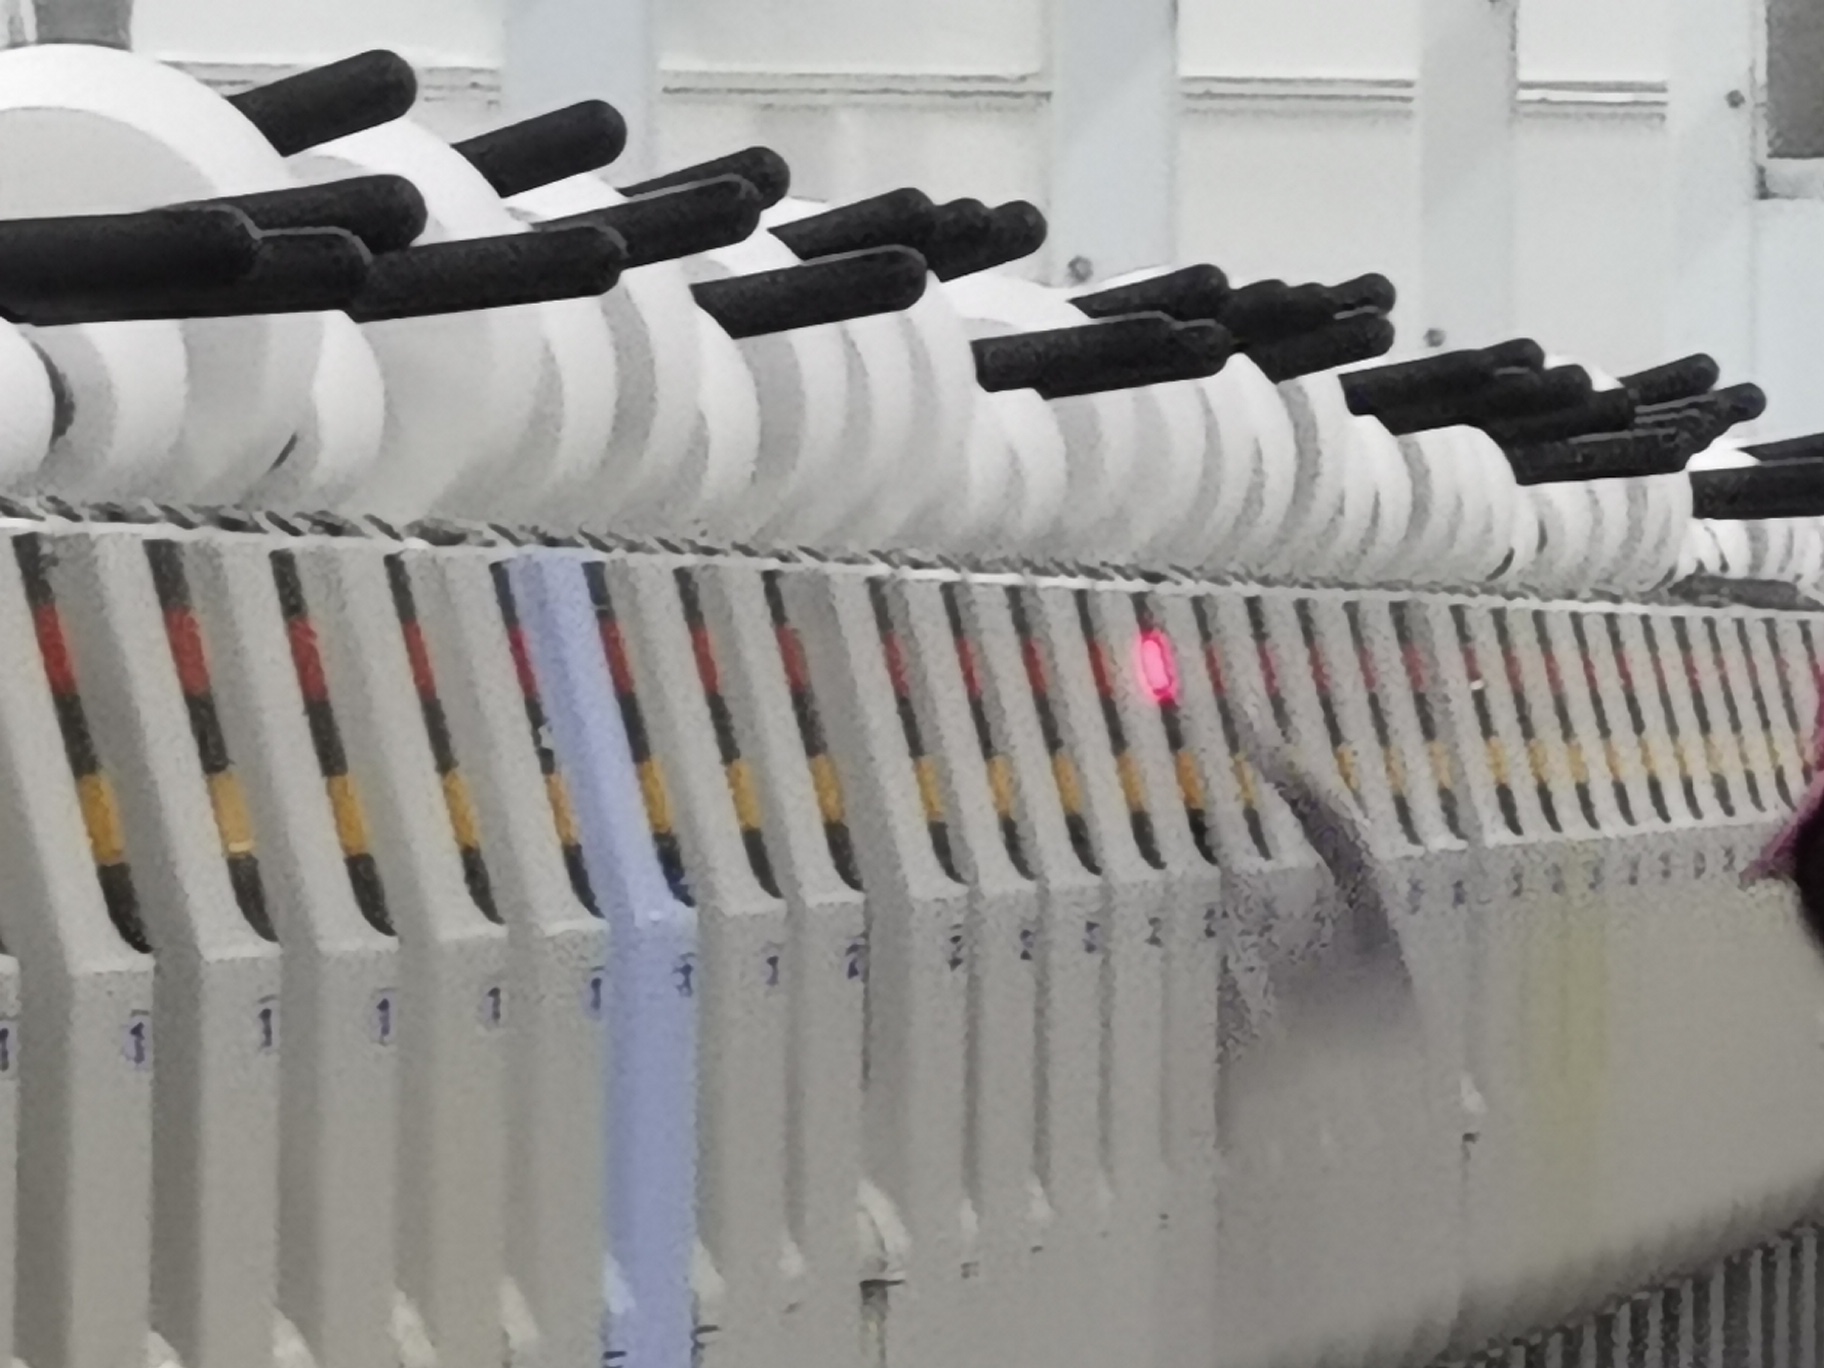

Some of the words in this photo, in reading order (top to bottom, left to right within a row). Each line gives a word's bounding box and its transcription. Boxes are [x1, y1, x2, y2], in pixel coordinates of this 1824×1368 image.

[376, 997, 390, 1039] 1
[487, 986, 501, 1023] 1
[130, 1022, 145, 1065] 1
[258, 1008, 272, 1048] 1
